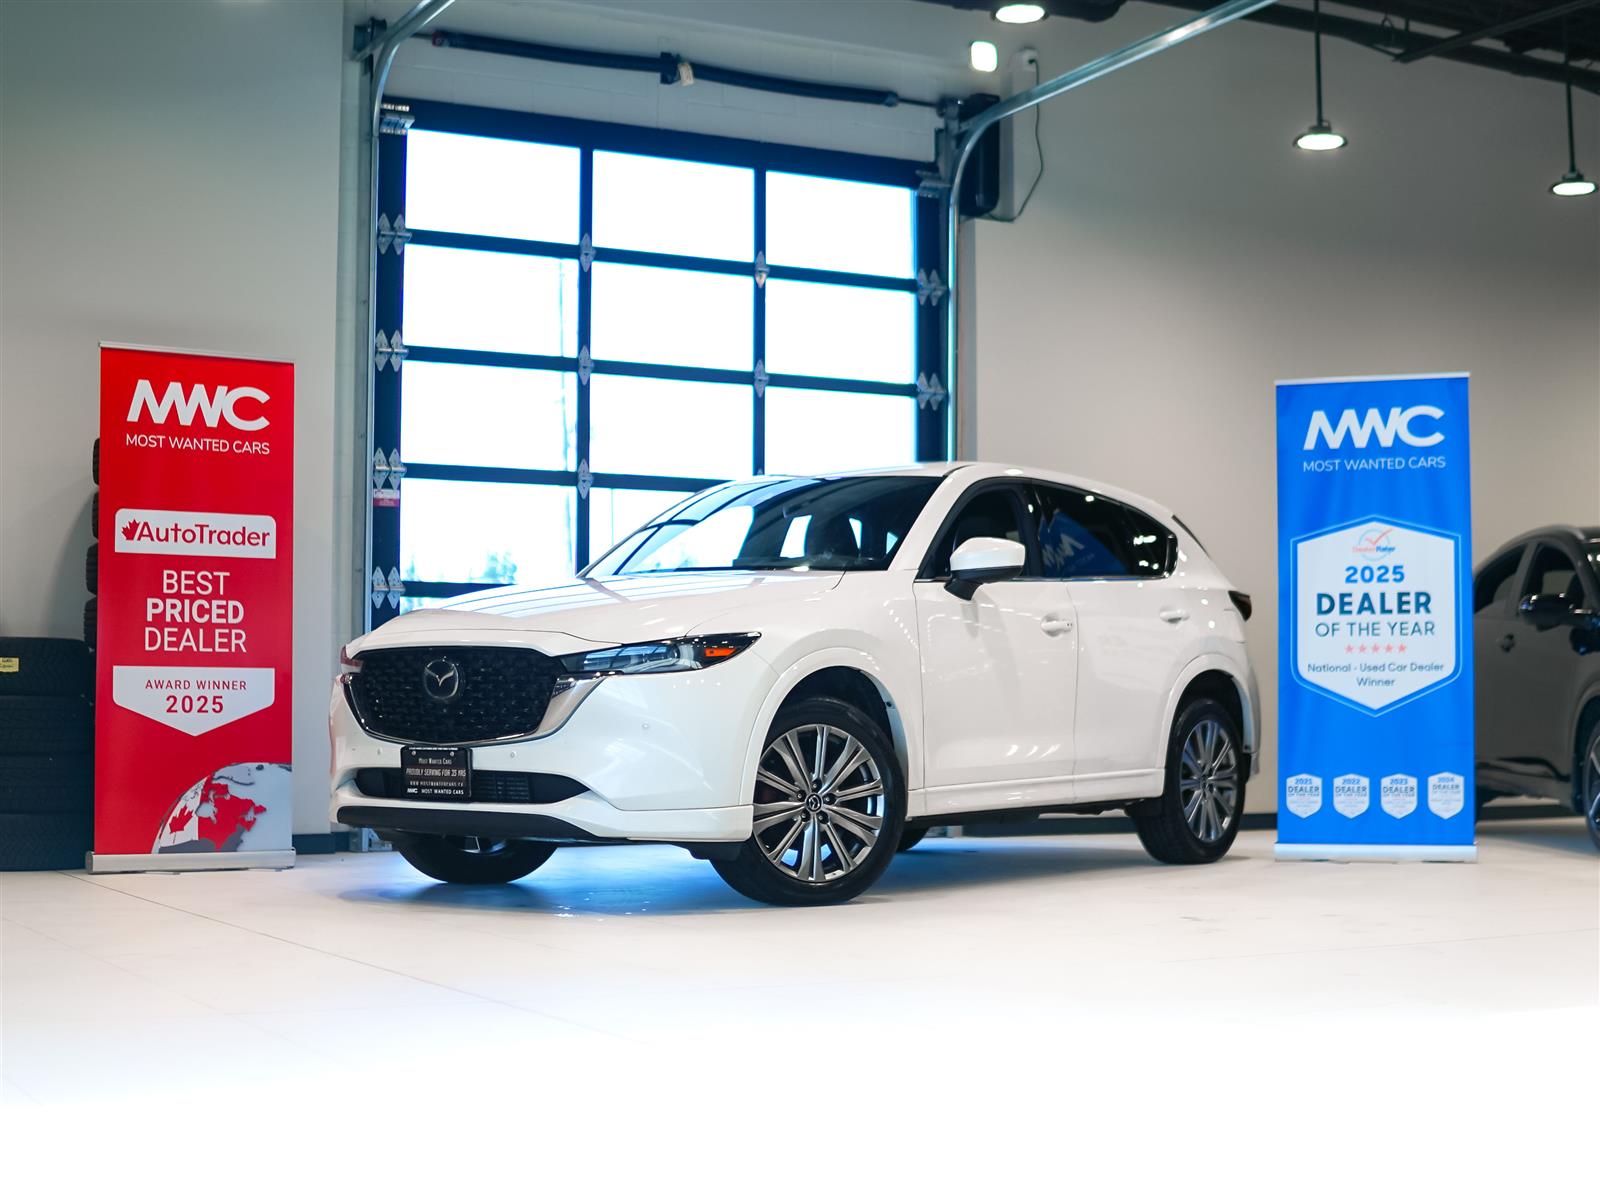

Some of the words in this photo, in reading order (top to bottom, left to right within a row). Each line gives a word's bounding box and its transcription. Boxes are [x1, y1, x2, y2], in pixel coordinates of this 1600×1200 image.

[126, 379, 270, 431] MWC
[1303, 405, 1445, 450] MWC
[126, 433, 165, 448] MOST
[168, 436, 230, 452] WANTED
[232, 440, 270, 455] CARS
[1303, 459, 1341, 472] MOST
[1344, 457, 1405, 471] WANTED
[1408, 456, 1446, 469] CARS
[136, 521, 270, 547] AutoTrader
[162, 569, 230, 595] BEST
[1345, 565, 1405, 584] 2025
[146, 597, 245, 624] PRICED
[1316, 591, 1432, 616] DEALER
[144, 626, 247, 653] DEALER
[1315, 622, 1342, 637] OF
[1346, 621, 1381, 637] THE
[1389, 621, 1435, 636] YEAR
[1307, 663, 1351, 673] National
[1360, 662, 1386, 672] Used
[1388, 663, 1407, 672] Car
[1410, 662, 1444, 672] Dealer
[145, 679, 191, 690] AWARD
[196, 680, 247, 691] WINNER
[1357, 676, 1396, 687] Winner
[165, 694, 224, 714] 2025
